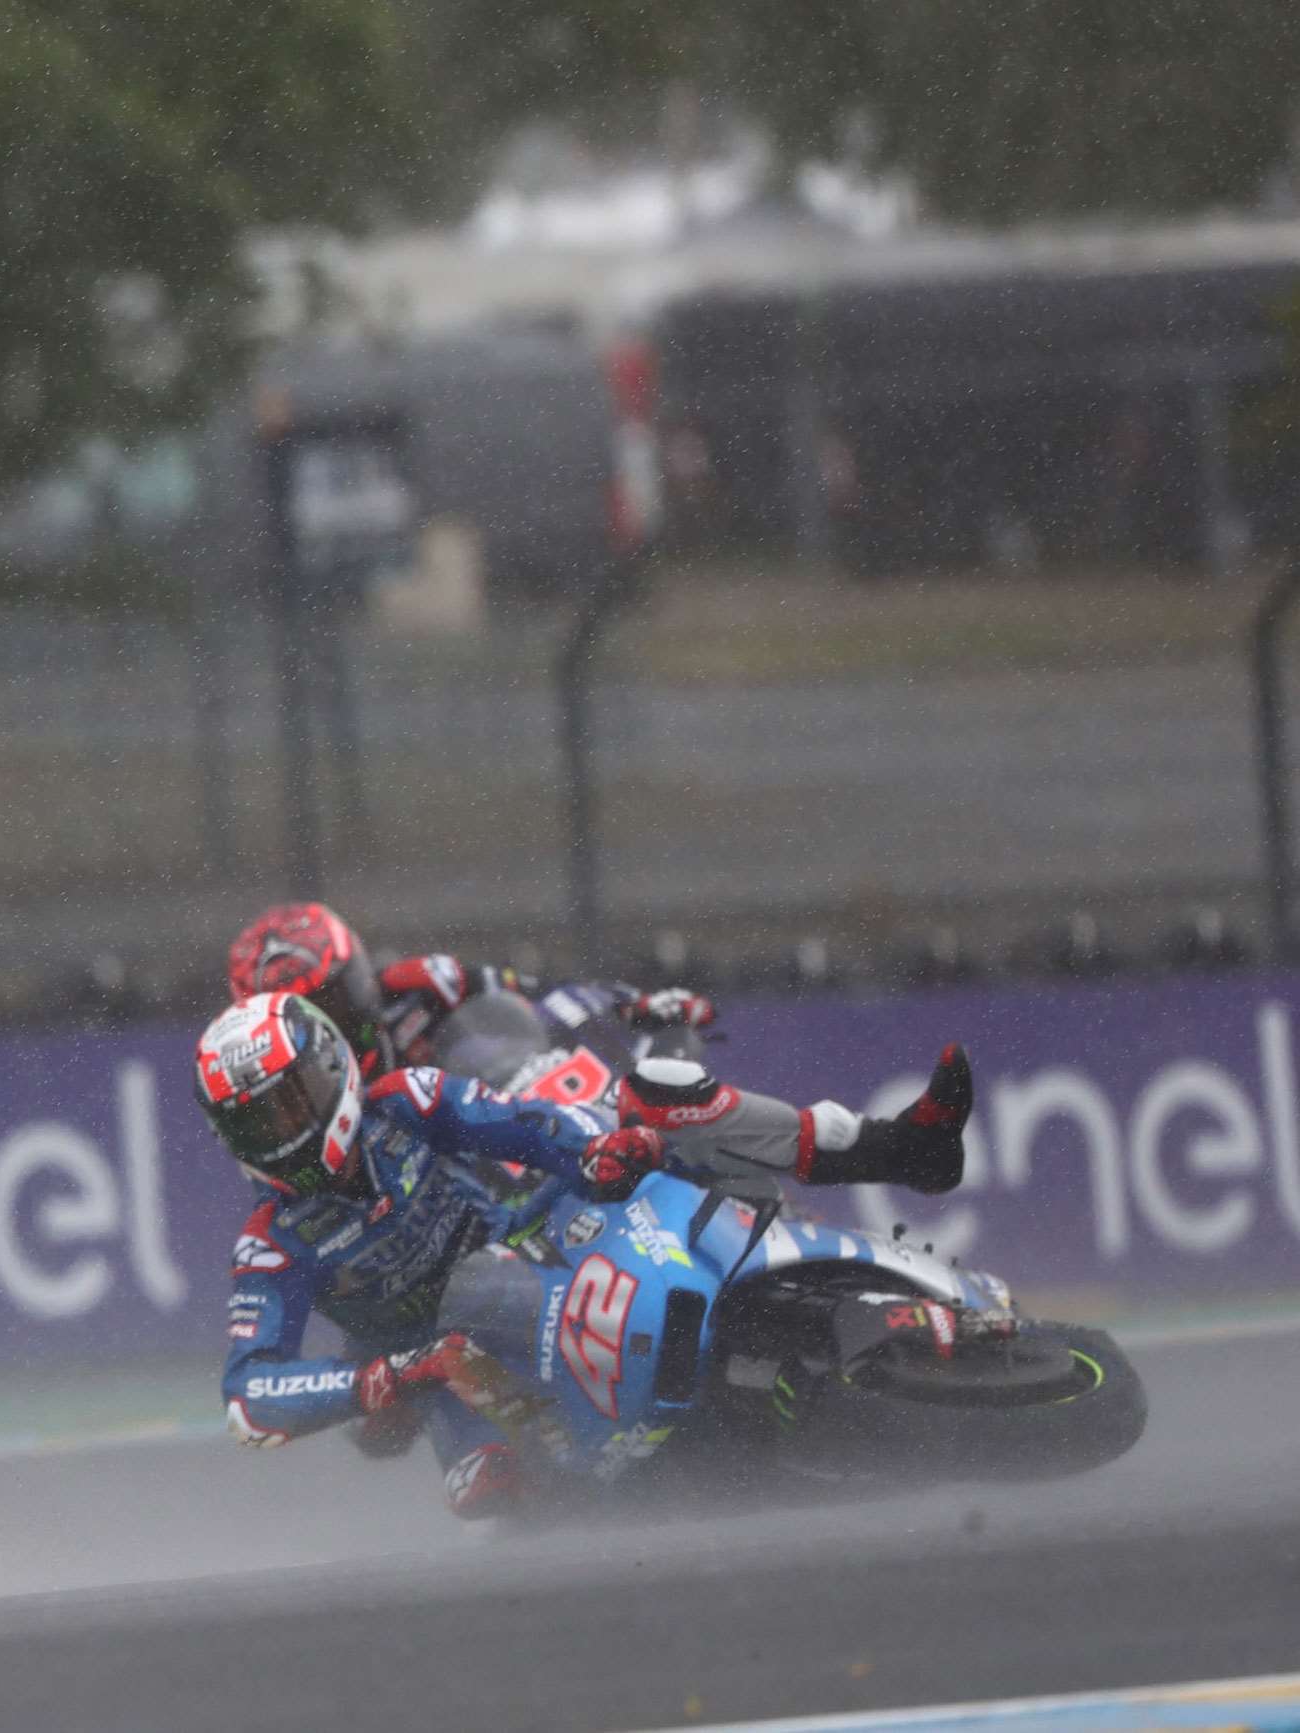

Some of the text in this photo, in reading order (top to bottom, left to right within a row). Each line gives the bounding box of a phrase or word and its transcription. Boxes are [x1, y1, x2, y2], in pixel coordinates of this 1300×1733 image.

[540, 1284, 566, 1382] SUZUKI
[560, 1253, 640, 1422] 42
[246, 1370, 357, 1399] SUZUKI
